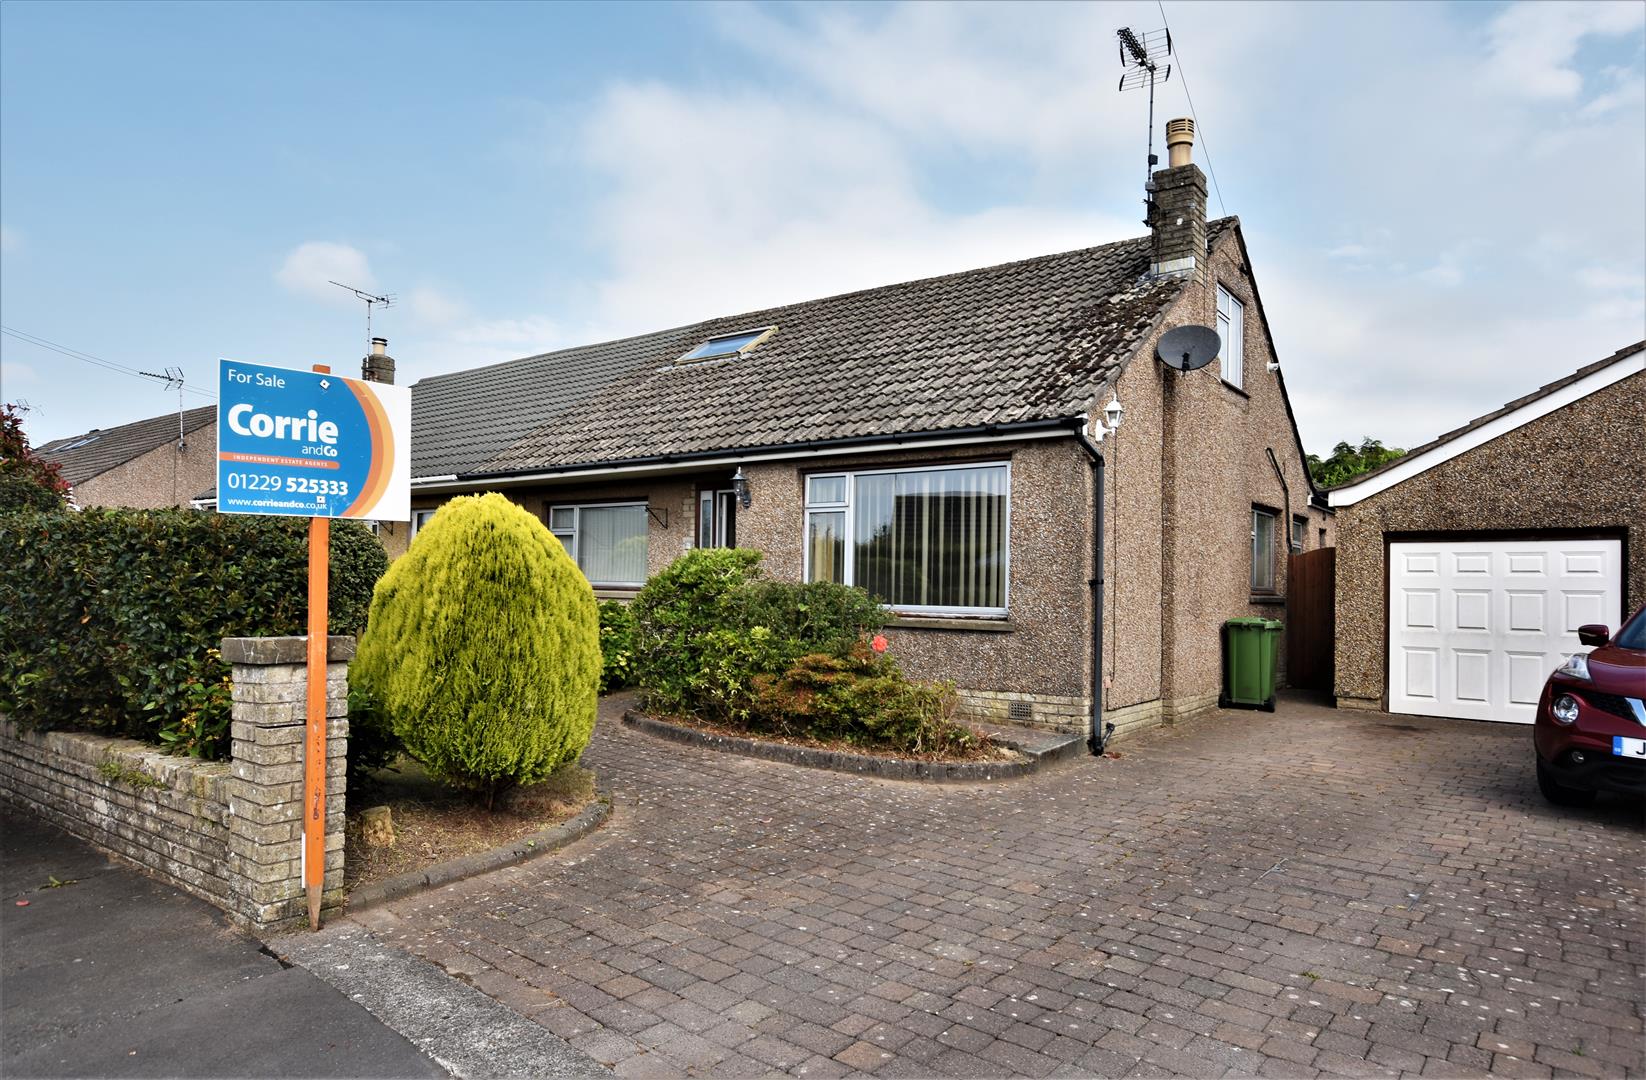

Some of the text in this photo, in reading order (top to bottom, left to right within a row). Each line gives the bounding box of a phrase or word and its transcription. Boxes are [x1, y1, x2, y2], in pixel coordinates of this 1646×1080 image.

[227, 368, 286, 388] For Sale
[227, 403, 339, 444] Corrie
[233, 455, 279, 463] INDEPENDENT
[227, 472, 349, 496] 01229 525333
[227, 498, 327, 510] www.corrieandco.co.uk
